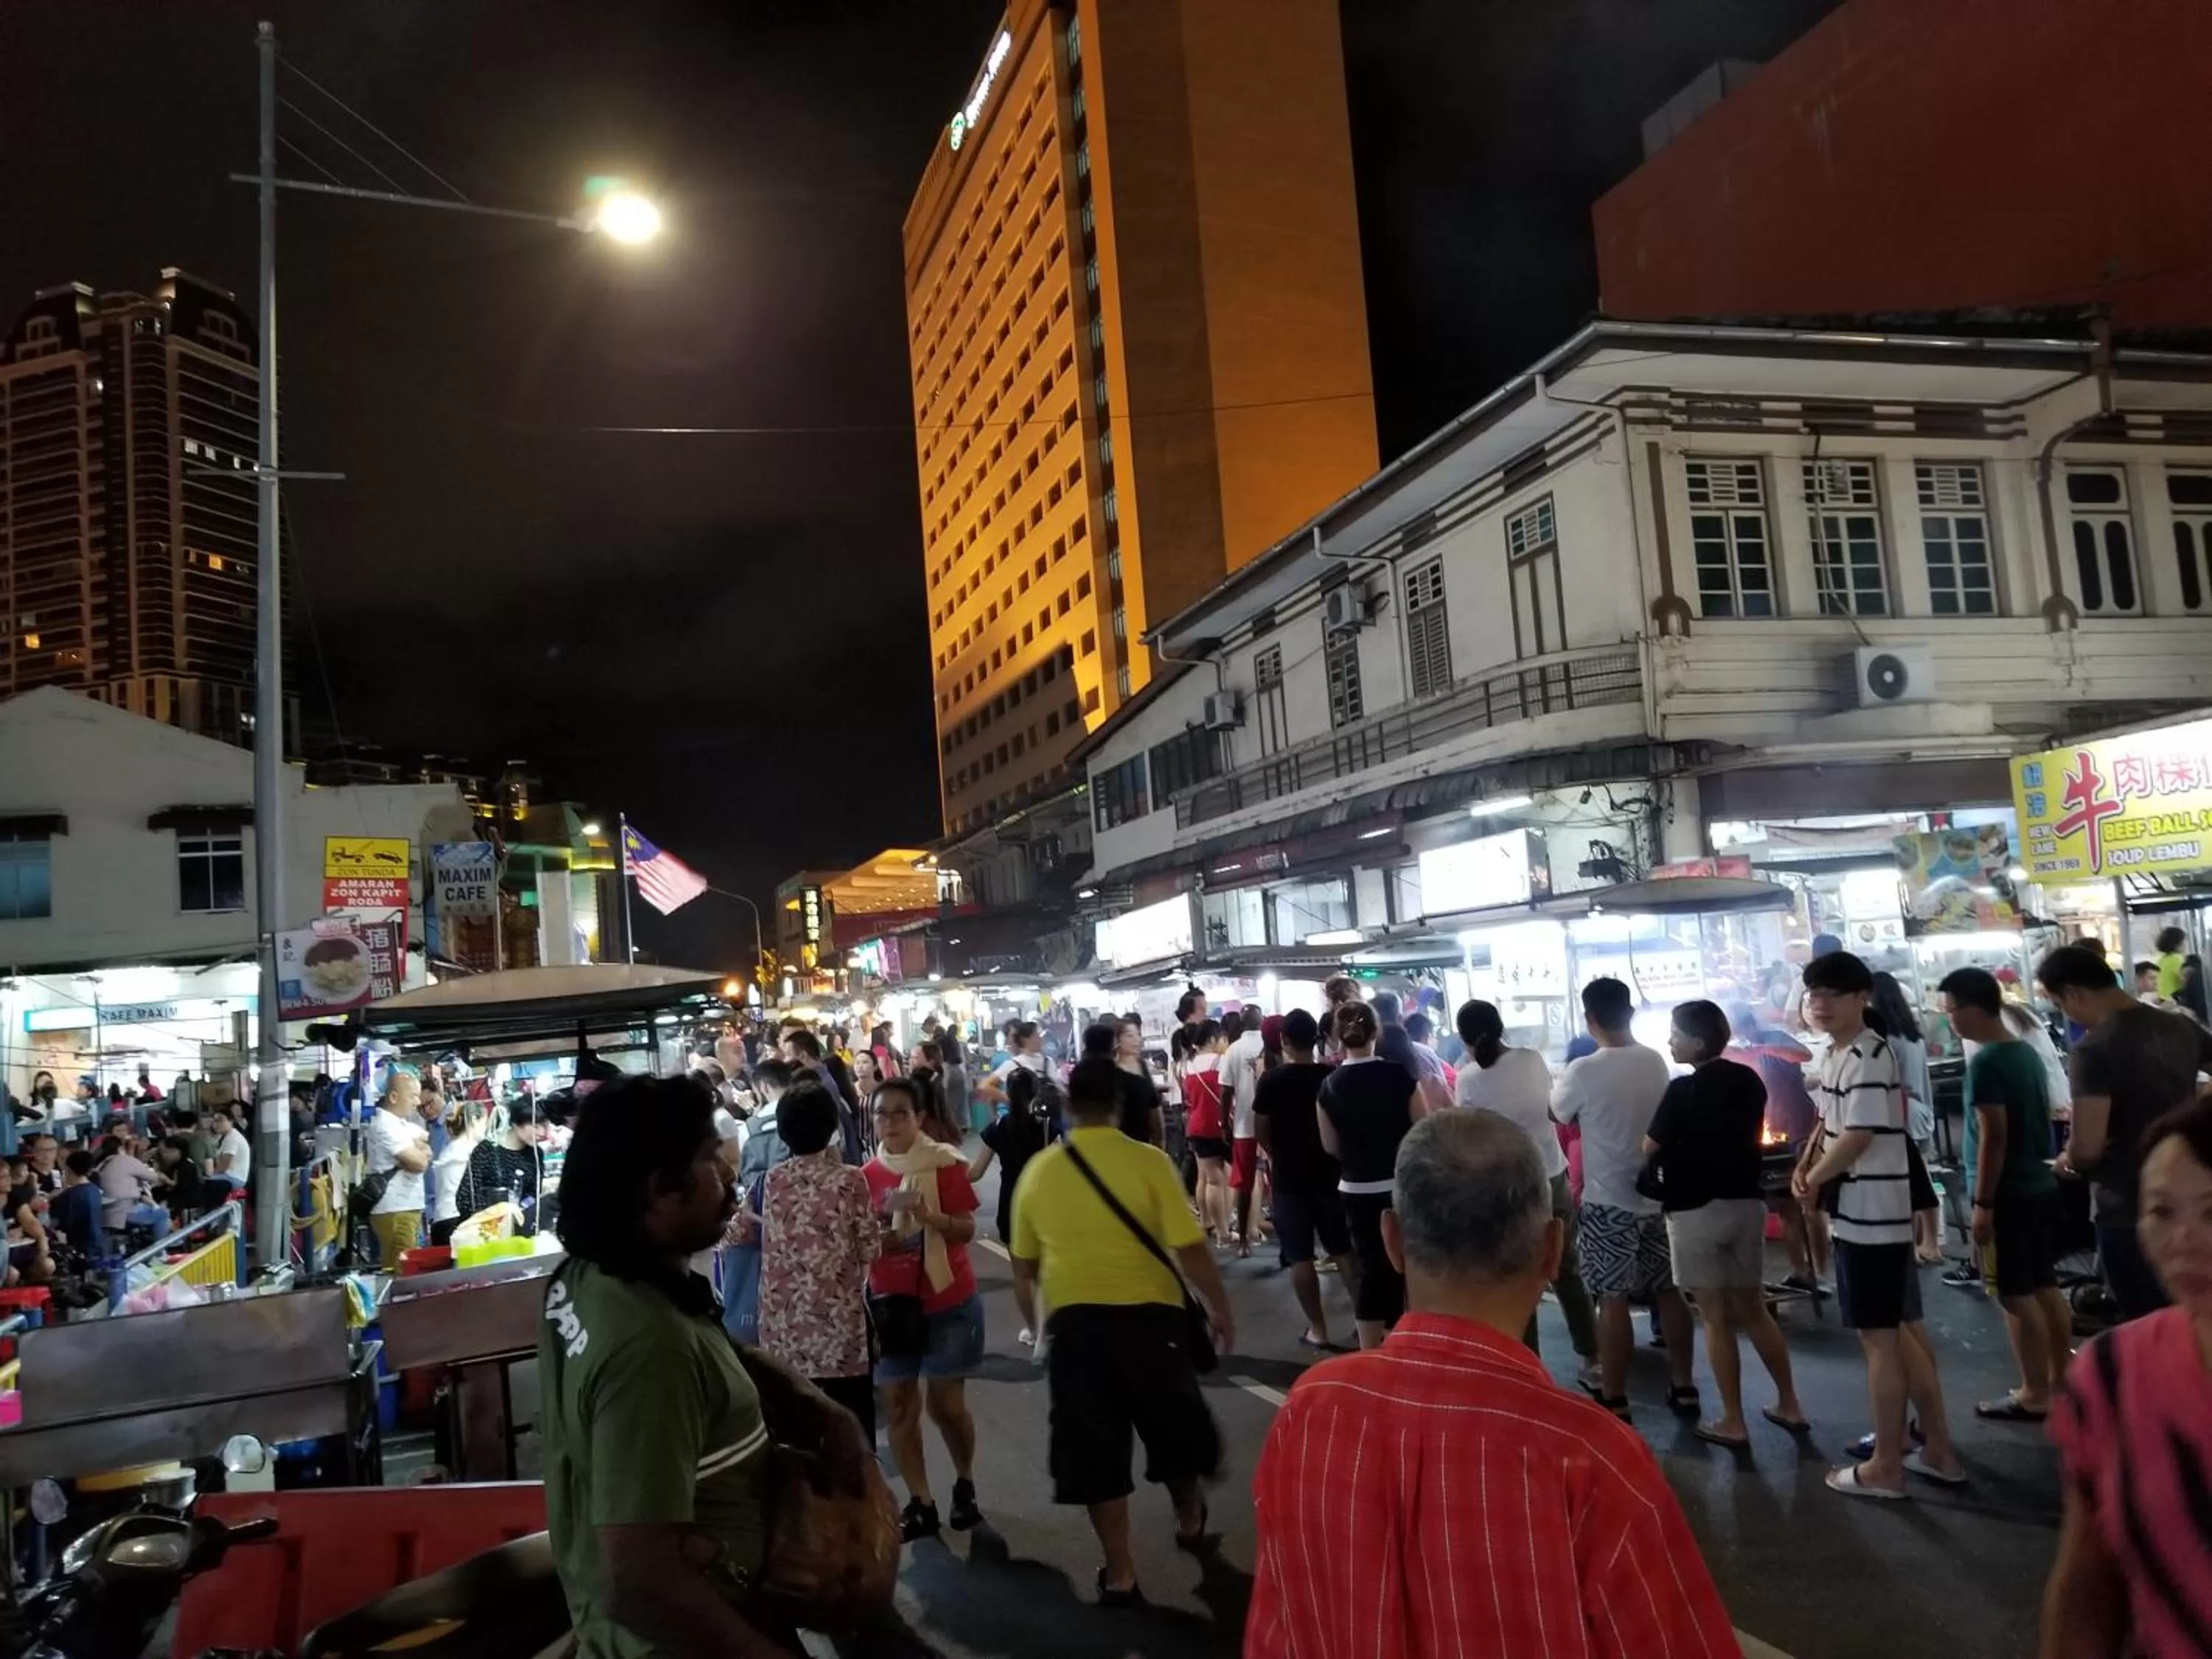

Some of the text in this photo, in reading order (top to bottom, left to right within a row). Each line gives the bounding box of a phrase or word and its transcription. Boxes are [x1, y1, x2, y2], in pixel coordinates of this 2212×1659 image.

[2104, 818, 2146, 841] BEEF
[2148, 812, 2197, 835] BALL
[2107, 840, 2199, 867] SOUP LEMBU
[2034, 860, 2056, 872] SINCE
[438, 869, 492, 883] MAXIM
[445, 887, 486, 901] CAFE
[347, 898, 383, 906] RODA
[136, 1006, 178, 1019] MAXIM
